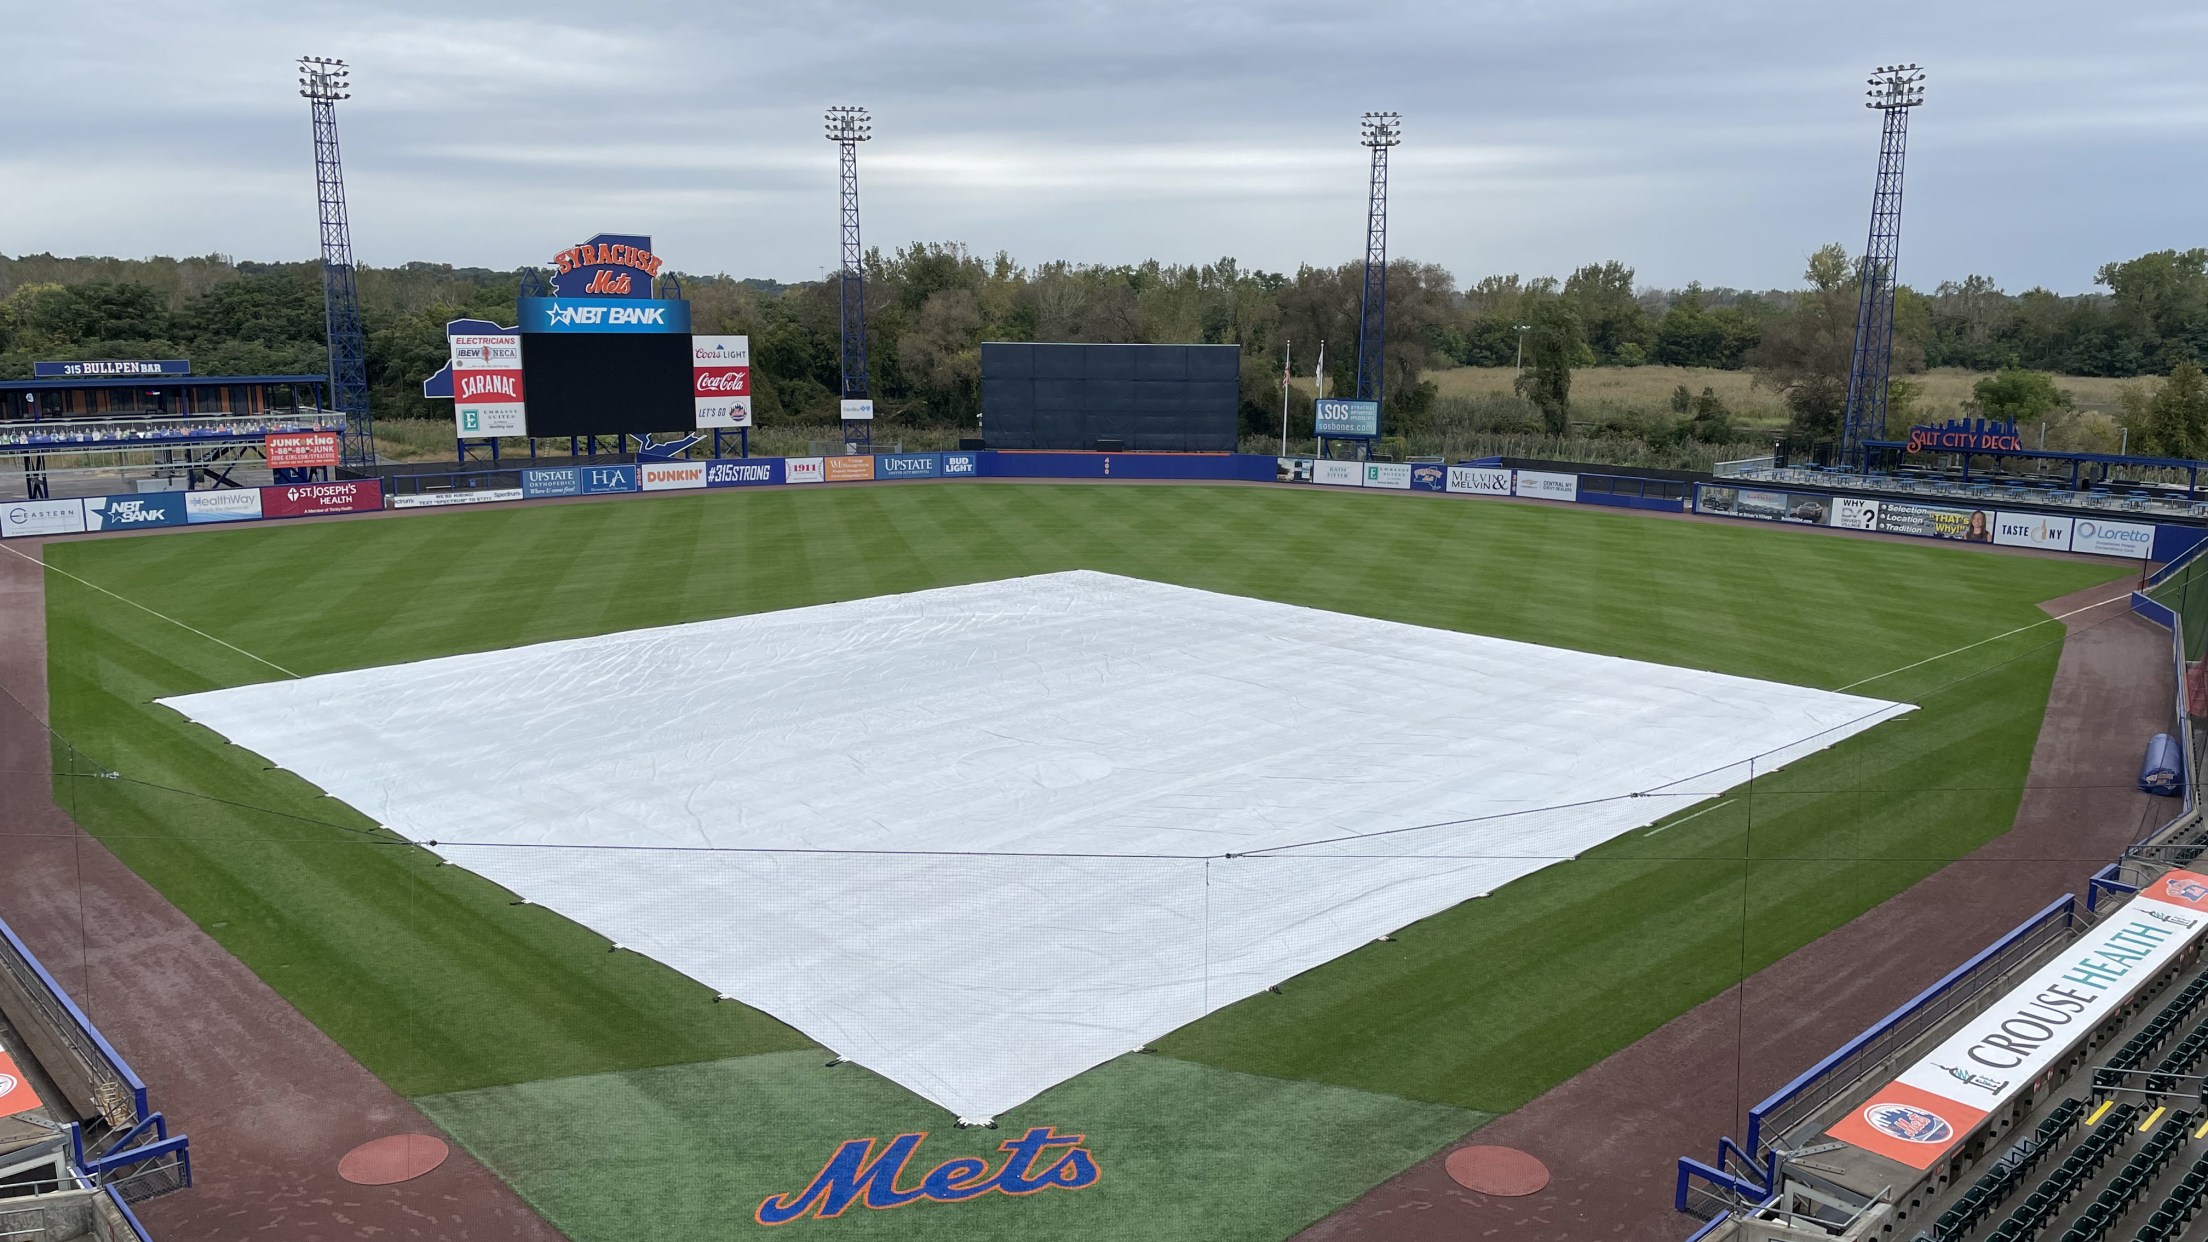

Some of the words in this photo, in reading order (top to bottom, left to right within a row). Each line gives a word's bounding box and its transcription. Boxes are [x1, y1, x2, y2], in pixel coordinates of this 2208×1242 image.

[554, 244, 662, 278] SYRACUSE
[586, 270, 632, 294] Mets
[565, 307, 607, 324] NBT
[608, 307, 666, 324] BANK
[695, 348, 720, 359] Coors
[64, 364, 81, 374] 315
[82, 362, 140, 374] BULLPEN
[140, 364, 161, 373] BAR
[461, 375, 517, 398] SARANAC
[696, 372, 746, 391] Coca-Cola
[699, 408, 716, 417] LET'S
[718, 408, 727, 416] GO
[1324, 404, 1348, 420] SOS
[466, 413, 476, 428] E
[1319, 422, 1374, 431] sosbones.com
[270, 438, 300, 447] JUNK
[306, 435, 334, 445] KING
[1906, 430, 1940, 454] SALT
[1942, 433, 1978, 448] CITY
[1982, 435, 2021, 450] DECK
[794, 464, 816, 472] 1911
[884, 458, 932, 471] UPSTATE
[946, 464, 973, 472] LIGHT
[529, 470, 574, 482] UPSTATE
[647, 469, 702, 482] DUNKIN'
[708, 465, 770, 482] #315STRONG
[1451, 481, 1491, 489] MELVIN
[1452, 471, 1499, 482] MELVIN
[1492, 474, 1508, 490] &
[300, 488, 312, 497] ST.
[313, 483, 357, 498] JOSEPH'S
[110, 500, 144, 513] NBT
[193, 495, 255, 507] HealthWay
[320, 496, 352, 505] HEALTH
[1843, 499, 1865, 507] WHY
[23, 510, 75, 519] EASTERN
[121, 508, 165, 523] BANK
[1887, 504, 1928, 514] Selection
[1862, 509, 1875, 529] ?
[1886, 514, 1924, 524] Location
[1929, 513, 1969, 525] "THAT's
[1886, 523, 1922, 534] Tradition
[1935, 524, 1966, 534] Why!"
[2002, 525, 2029, 536] TASTE
[2049, 529, 2062, 540] NY
[2097, 526, 2150, 543] Loretto
[1968, 984, 2098, 1070] CROUSE
[2062, 922, 2174, 990] HEALTH
[1894, 1113, 1931, 1137] Mets
[754, 1126, 1101, 1226] Mets
